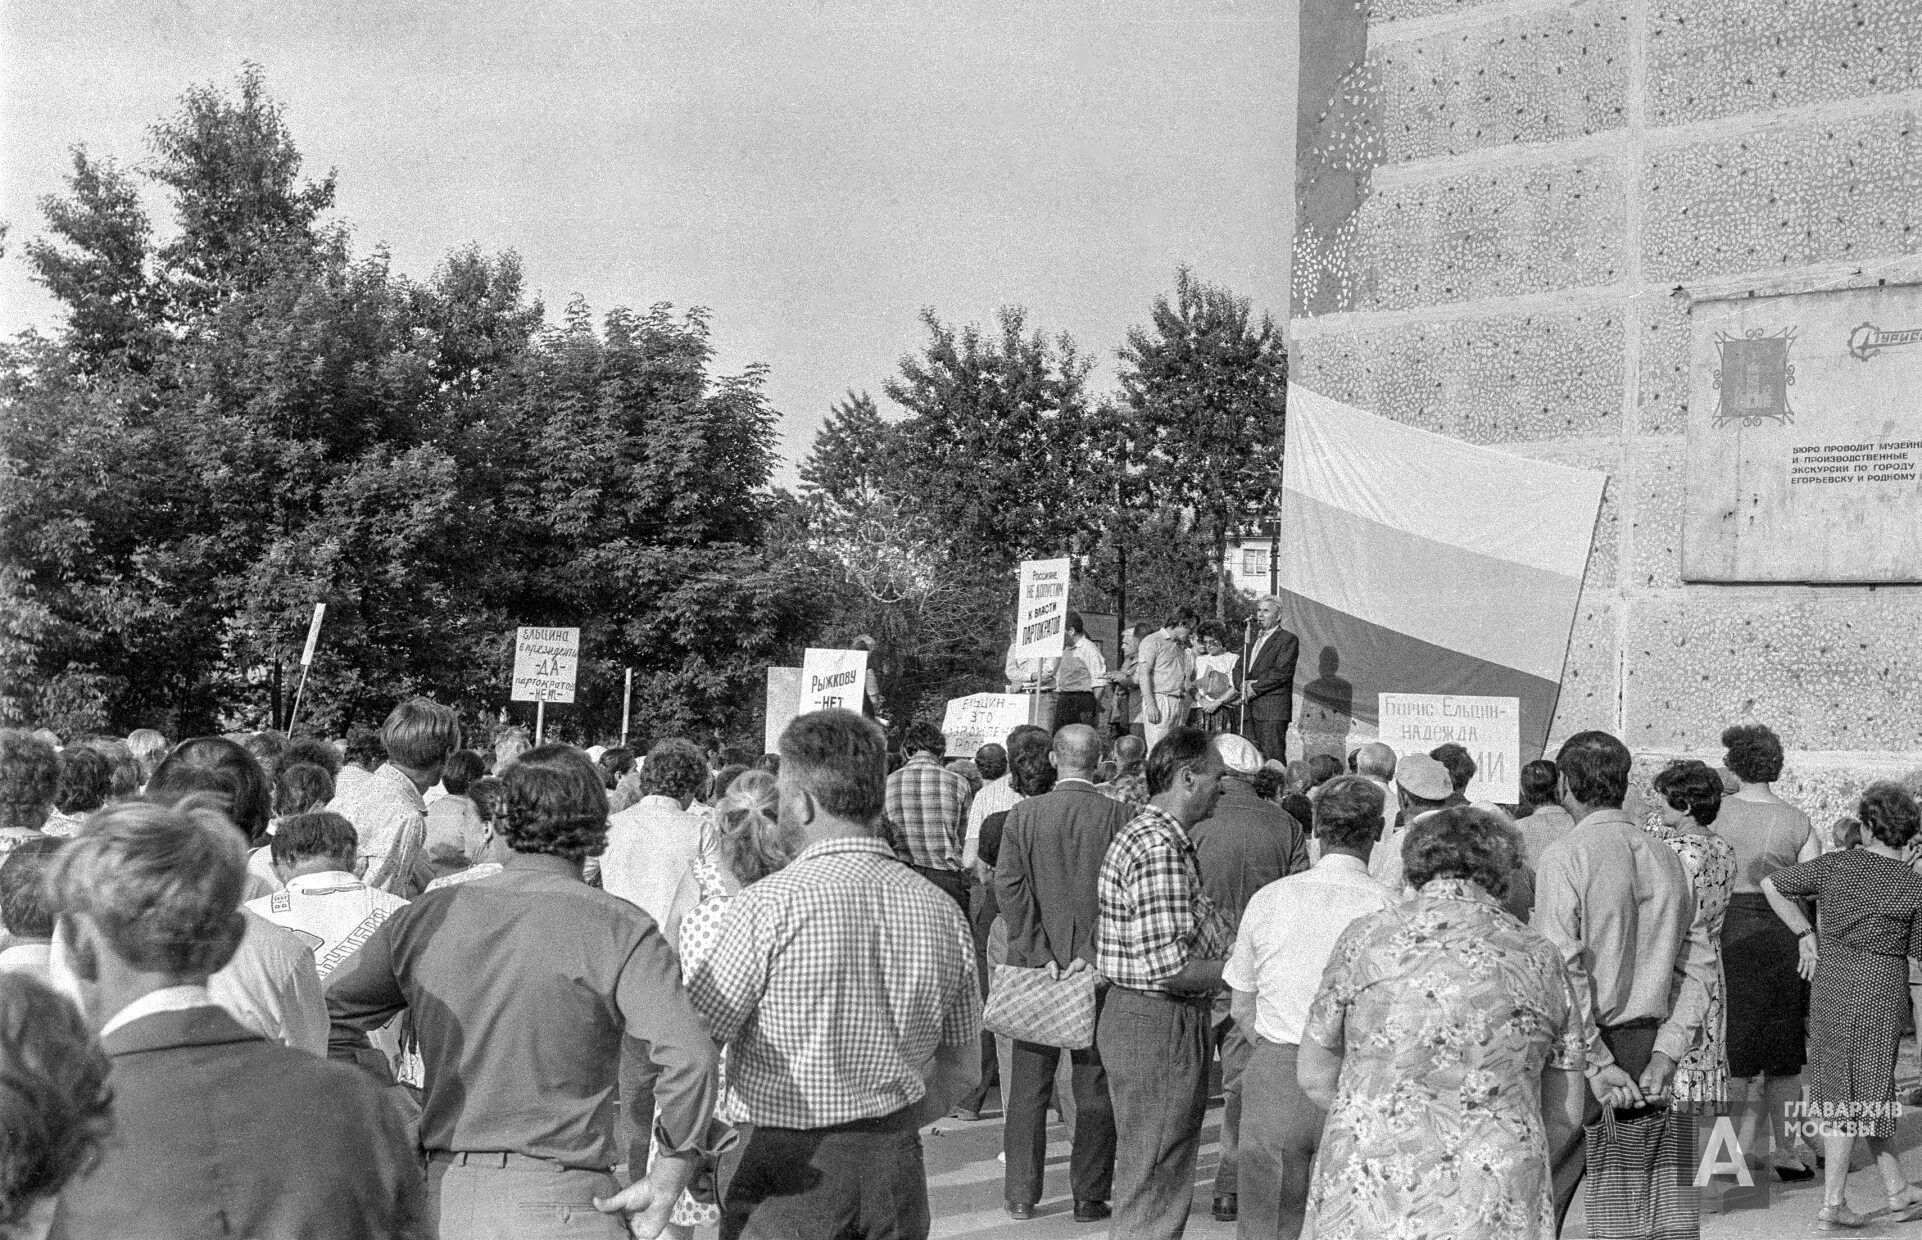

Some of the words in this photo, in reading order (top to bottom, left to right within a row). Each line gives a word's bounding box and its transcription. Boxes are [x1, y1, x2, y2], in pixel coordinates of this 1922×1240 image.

[1793, 446, 1820, 454] БЮРО
[1824, 443, 1875, 453] ПРОВОДИТ
[1878, 440, 1922, 451] МУЗЕЙН
[1804, 452, 1908, 463] ПРОИЗВОДСТВЕННЫЕ
[1791, 465, 1849, 474] ЭКСКУРСИИ
[1854, 464, 1868, 472] ПО
[1873, 462, 1915, 472] ГОРОДУ
[1791, 475, 1854, 485] ЕГОРЬЕВСКУ
[1867, 473, 1916, 482] РОДНОМУ
[1026, 584, 1035, 598] НЕ
[1034, 601, 1057, 618] ВЛАСТИ
[1022, 615, 1061, 646] ПАРТОКРАТОВ
